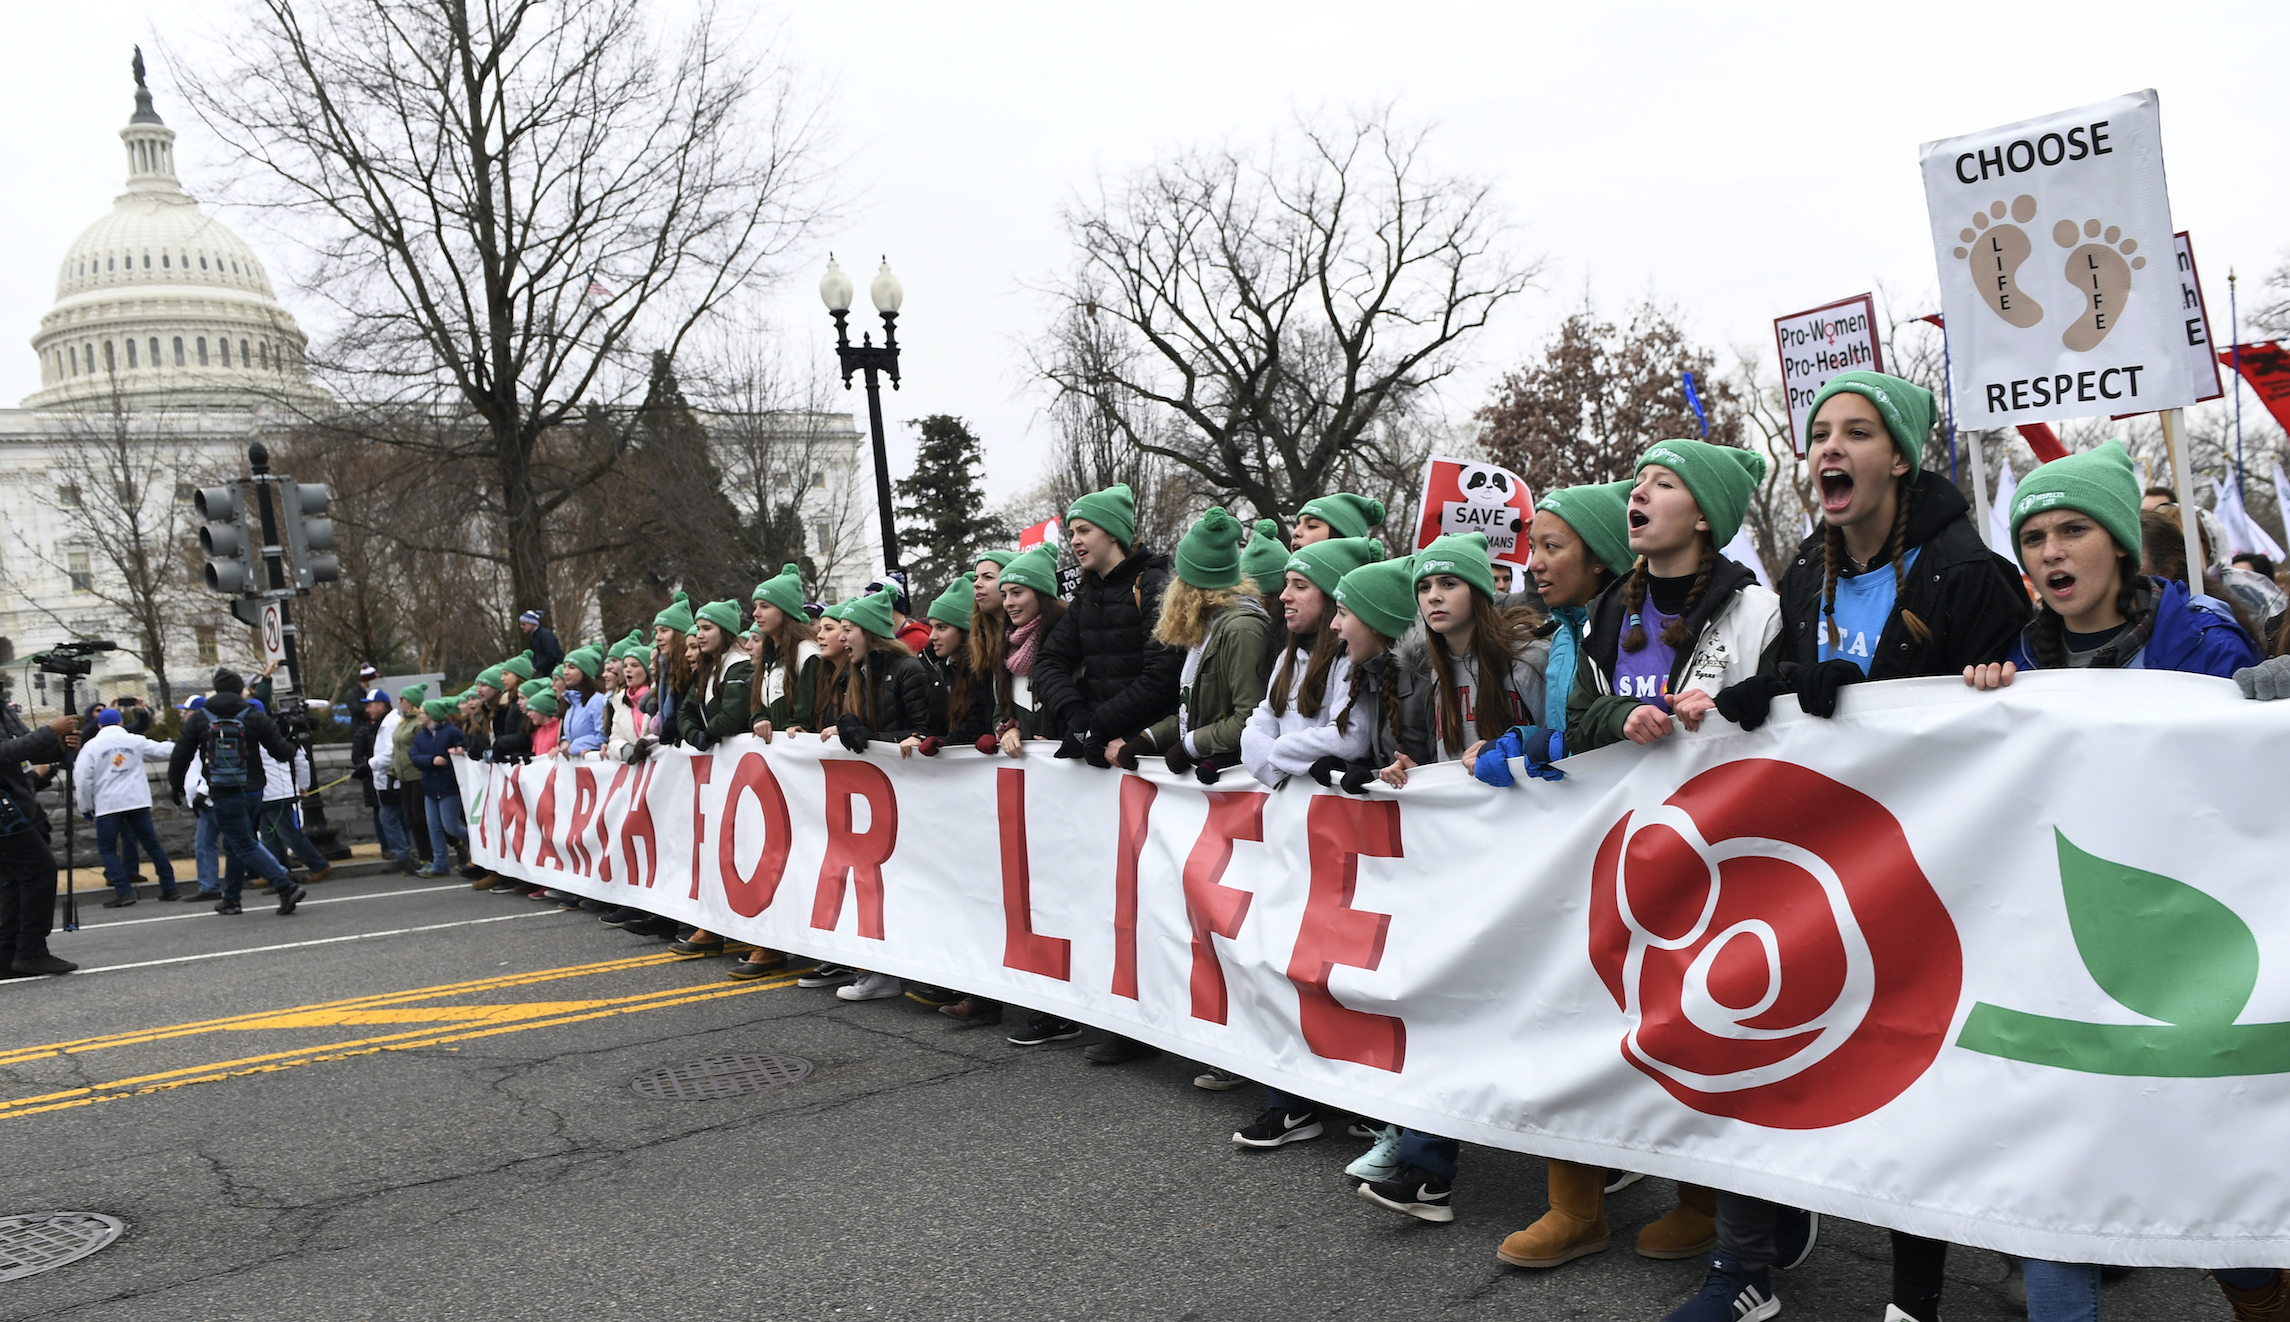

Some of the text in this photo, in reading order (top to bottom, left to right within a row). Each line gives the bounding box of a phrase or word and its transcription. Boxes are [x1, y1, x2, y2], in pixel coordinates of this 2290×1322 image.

[1955, 120, 2113, 184] CHOOSE
[1991, 236, 2012, 311] LIFE
[2087, 253, 2107, 330] LIFE
[1780, 313, 1868, 350] Pro-Women
[1784, 340, 1873, 380] Pro-Health
[1986, 365, 2144, 413] RESPECT
[1455, 506, 1506, 526] SAVE
[1488, 535, 1514, 549] MANS
[1062, 580, 1077, 592] TO
[1063, 566, 1081, 581] PRA
[1817, 621, 1882, 658] STA
[1618, 674, 1670, 698] SM
[499, 752, 1407, 1074] MARCH FOR LIFE
